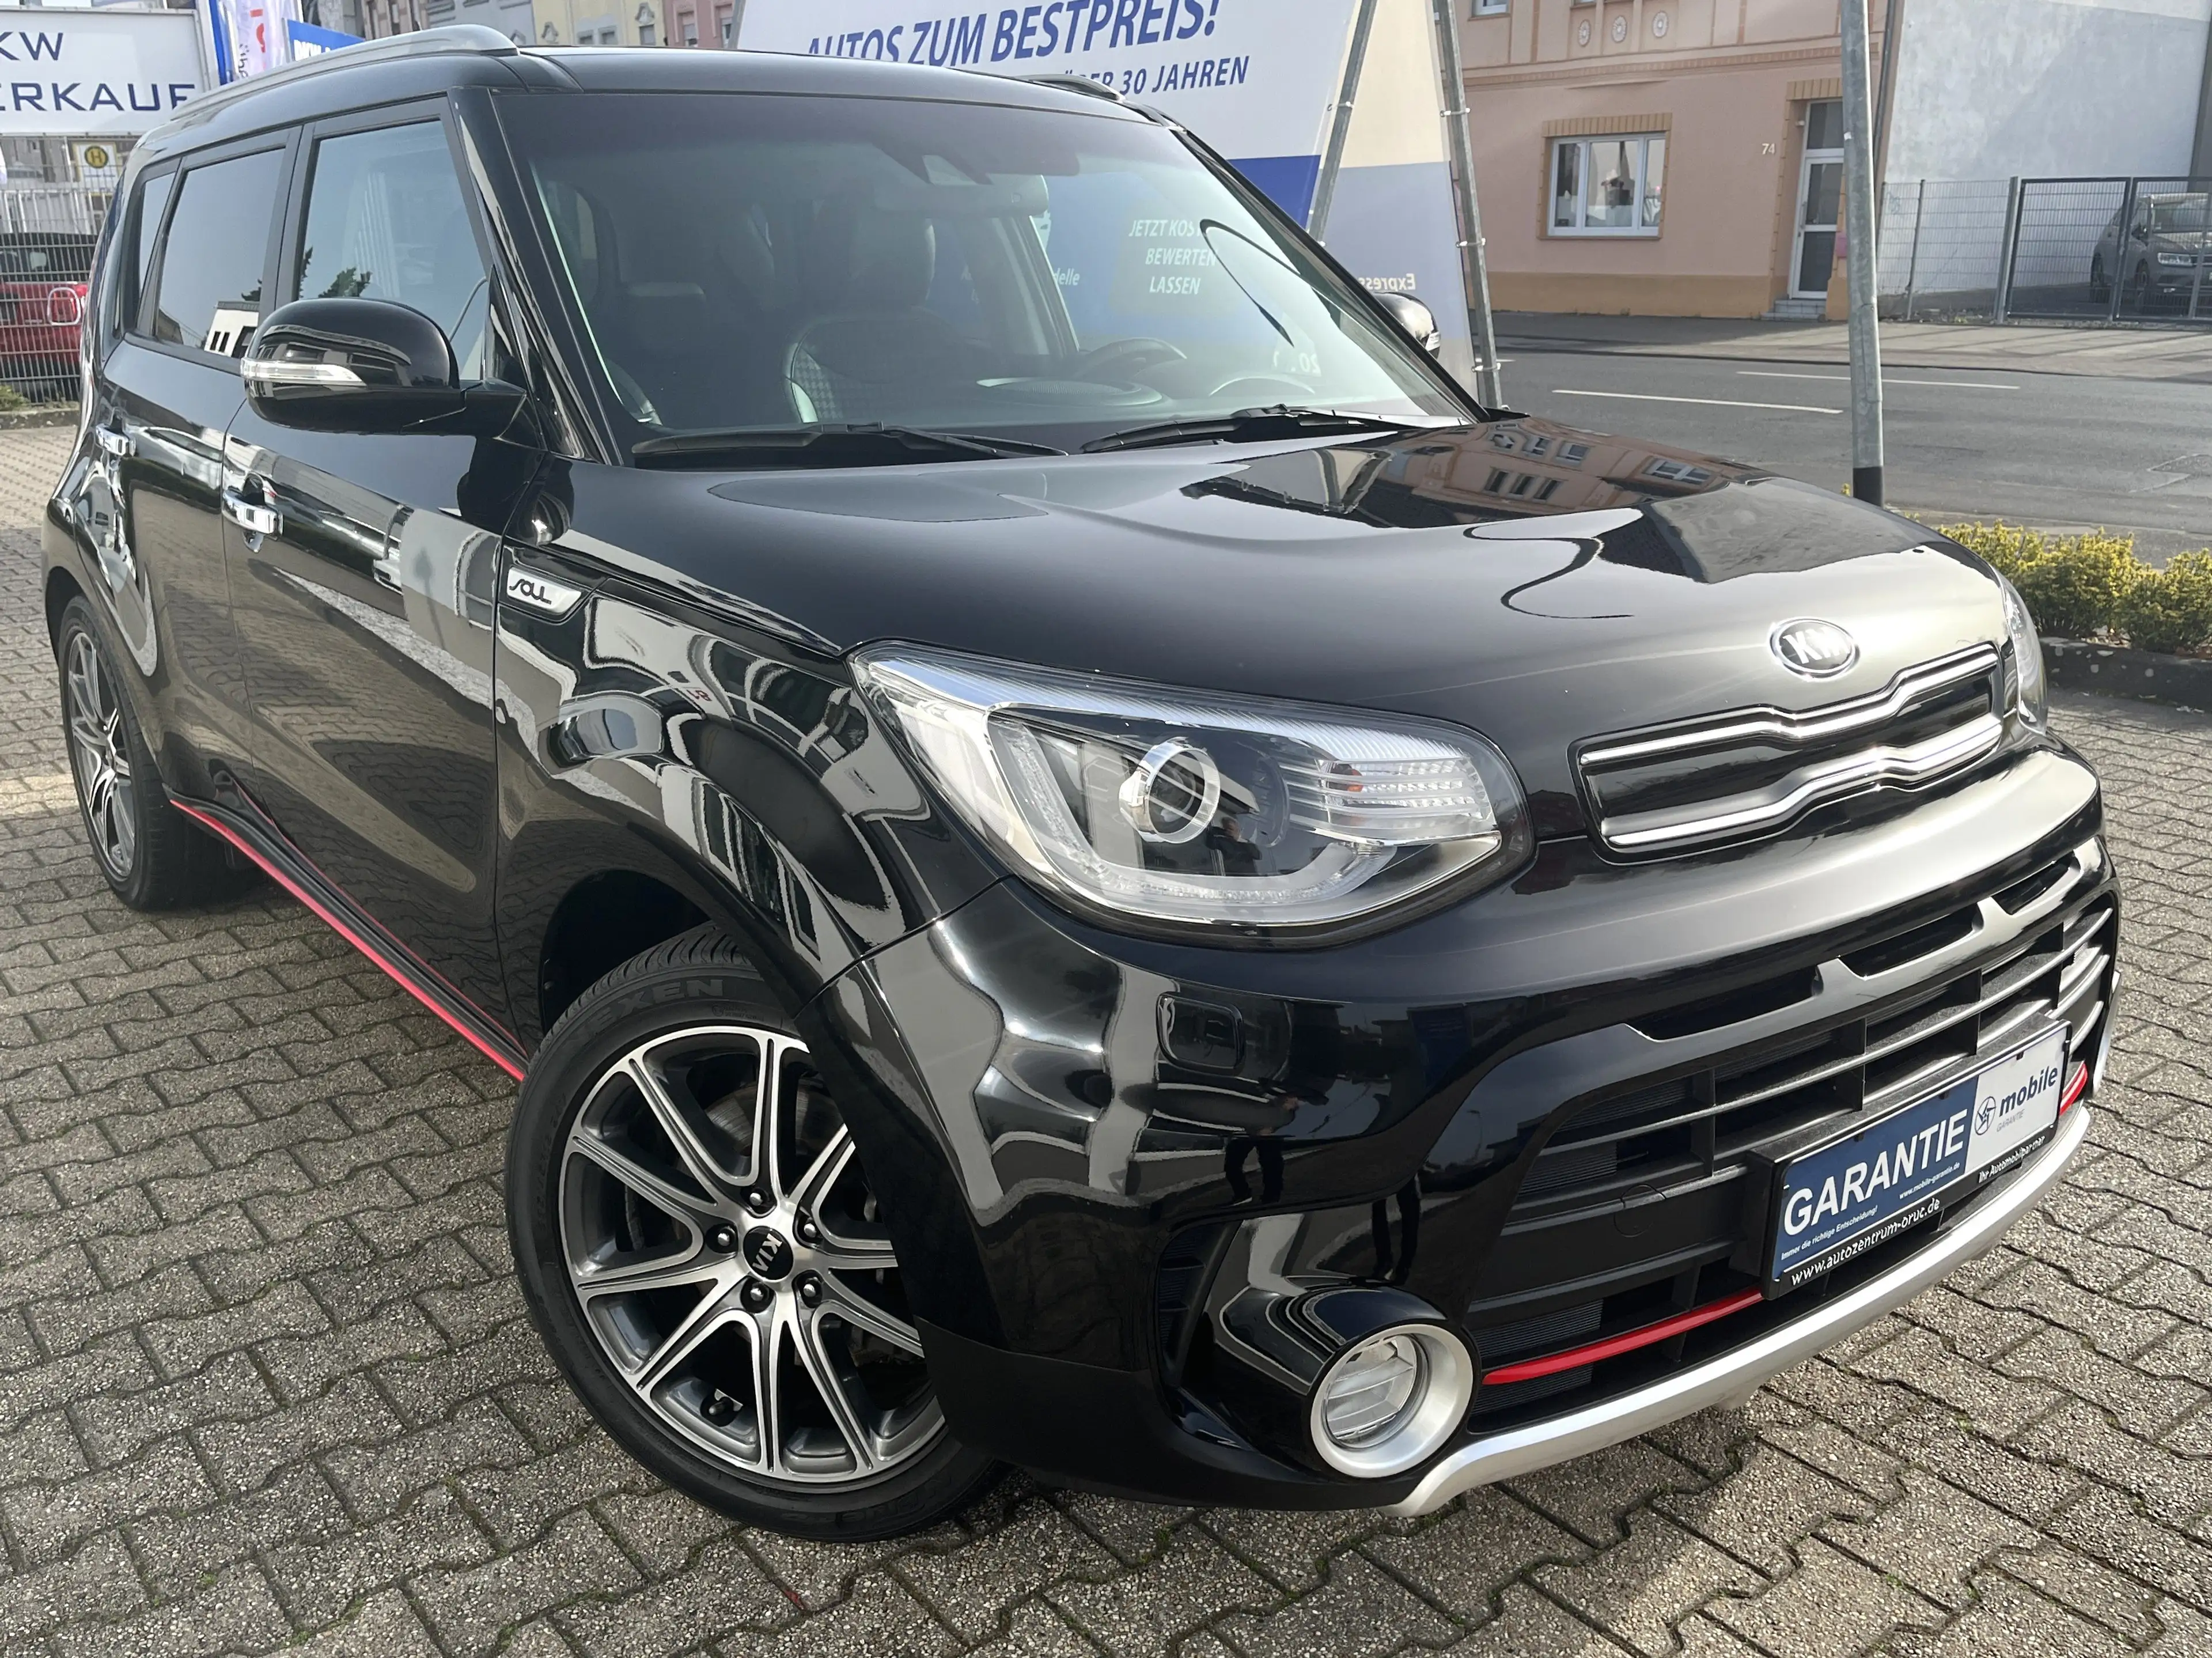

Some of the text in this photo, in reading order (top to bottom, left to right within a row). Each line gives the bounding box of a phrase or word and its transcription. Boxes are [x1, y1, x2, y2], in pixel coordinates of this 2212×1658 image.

[908, 13, 987, 67] ZUM
[990, 0, 1219, 62] BESTPREIS!
[1120, 69, 1147, 95] 30
[1152, 56, 1249, 93] JAHREN
[0, 83, 195, 111] RKAUF
[91, 151, 103, 164] H
[1762, 143, 1775, 154] 74
[1128, 219, 1168, 237] JETZT
[1145, 248, 1218, 267] BEWERTEN
[1149, 276, 1200, 294] LASSEN
[579, 979, 724, 1037] EXEN
[1999, 1066, 2058, 1118] mobile
[1997, 1108, 2025, 1132] GARANTIE
[1784, 1109, 1967, 1235] GARANTIE
[1978, 1135, 2045, 1183] Ihr Automobilpartner
[1781, 1205, 1878, 1260] Immer die richtige Entscheidung!
[1791, 1197, 1940, 1286] www.autozentrum-oruc.de
[752, 1233, 783, 1272] KIA
